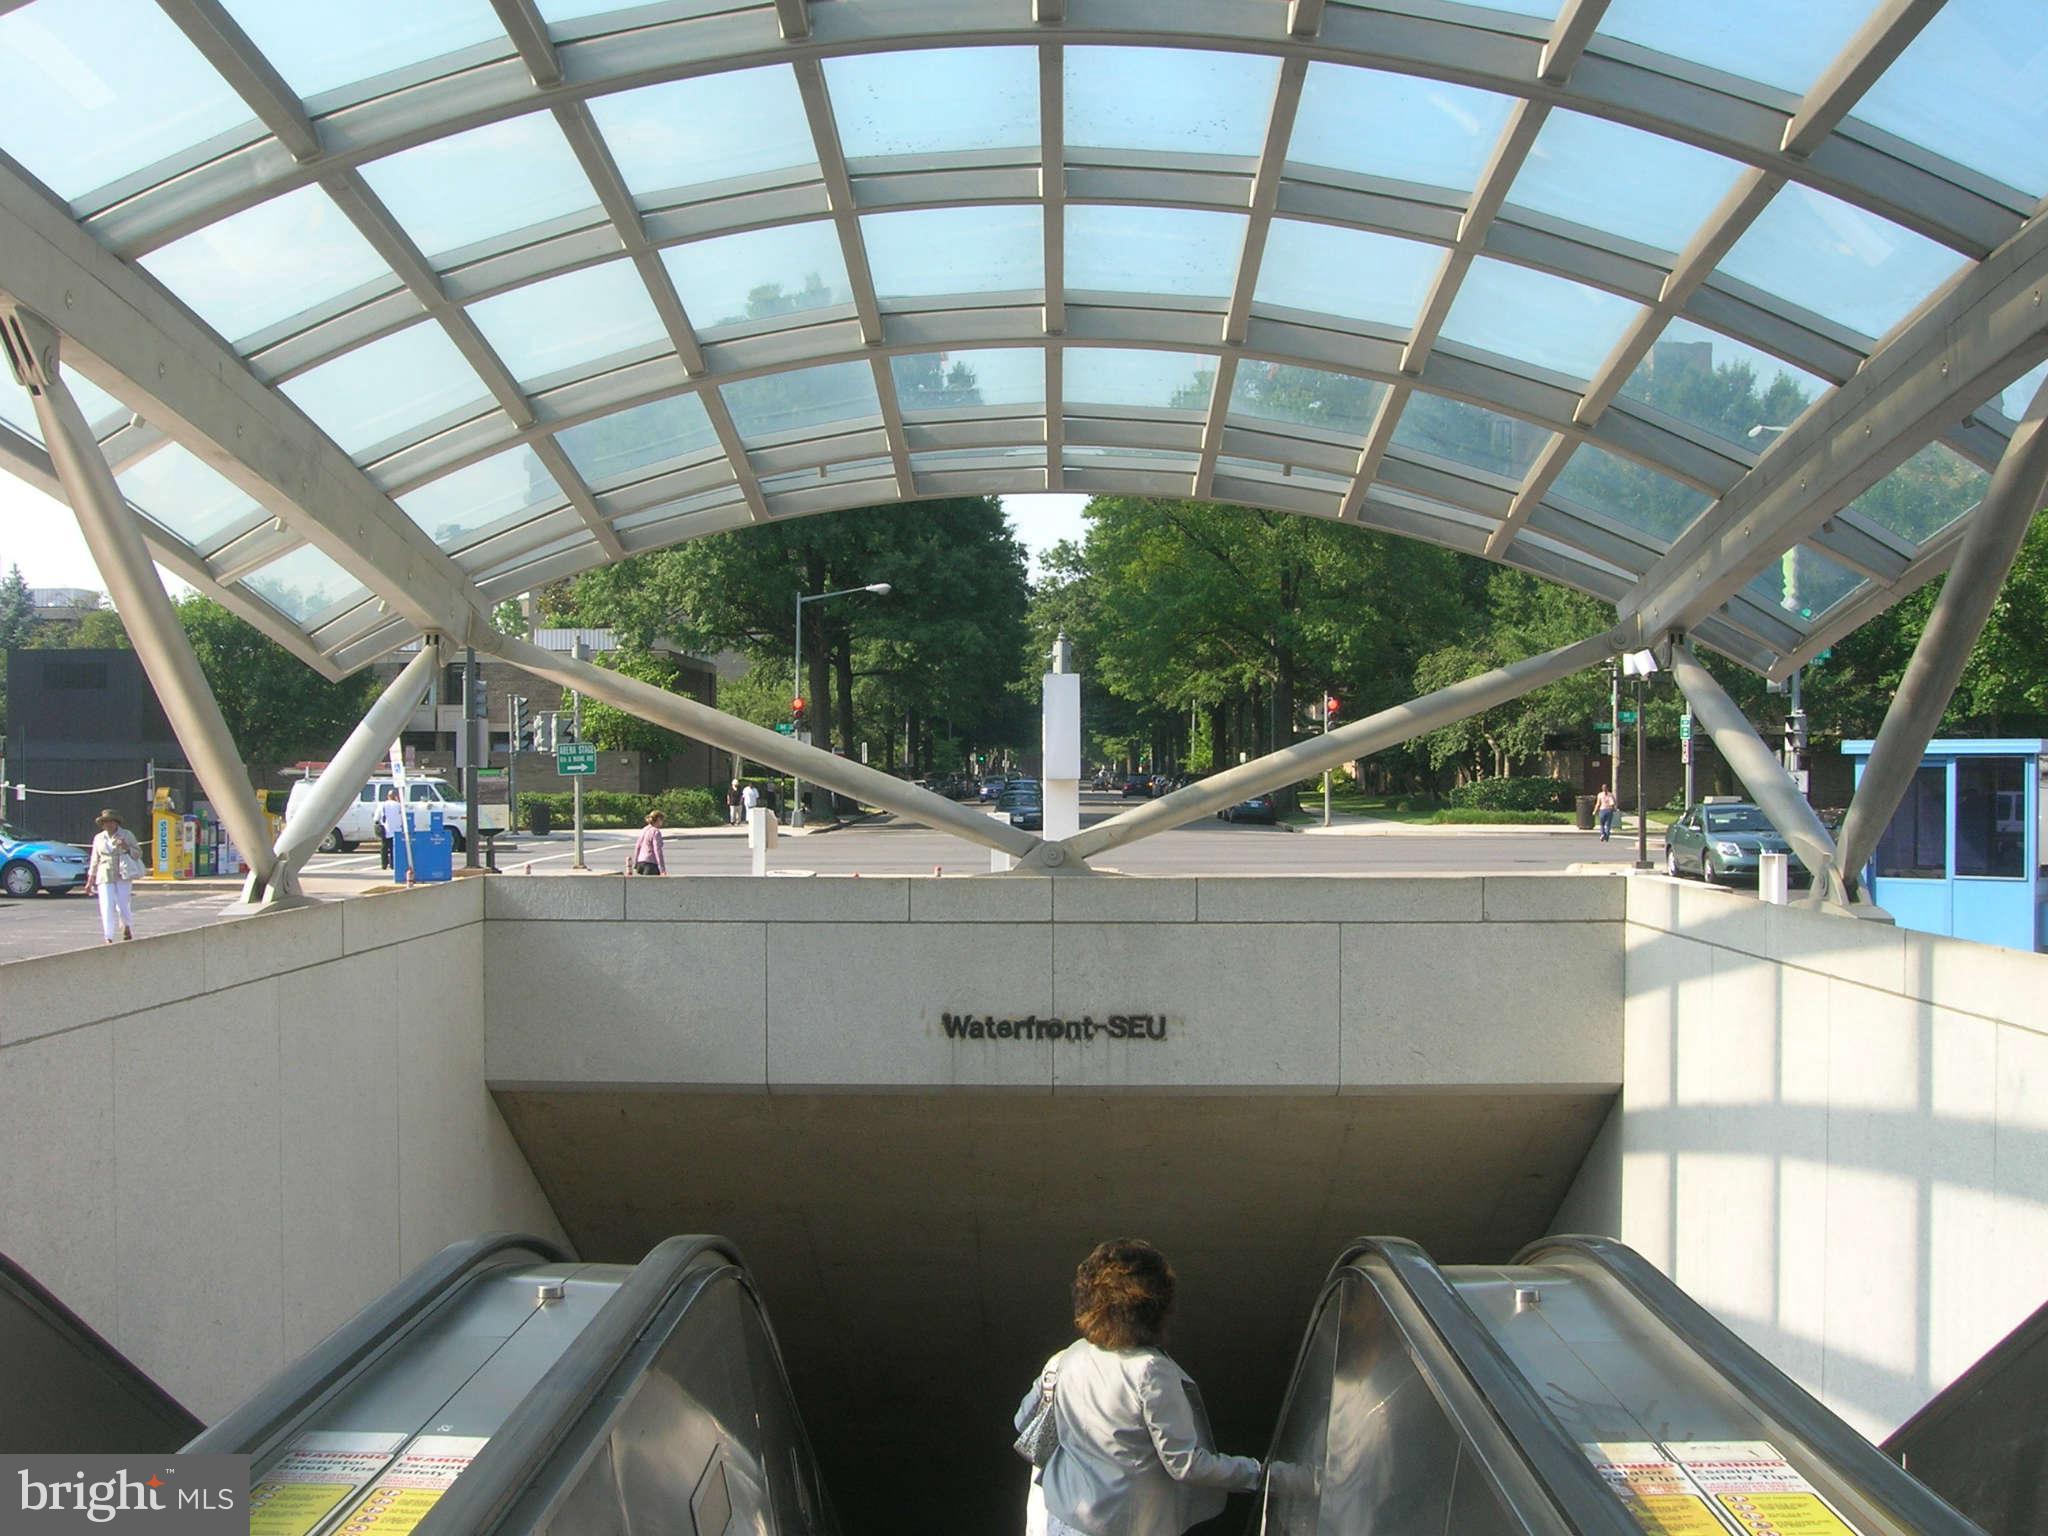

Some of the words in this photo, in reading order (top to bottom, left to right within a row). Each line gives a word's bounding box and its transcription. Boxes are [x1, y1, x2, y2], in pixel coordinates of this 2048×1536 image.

[941, 1013, 1168, 1042] Waterfront-SEU
[294, 1451, 389, 1460] WARNING
[283, 1458, 367, 1466] Escalator
[1687, 1460, 1786, 1469] WARNING
[276, 1464, 333, 1472] Safety
[390, 1468, 447, 1476] Safety
